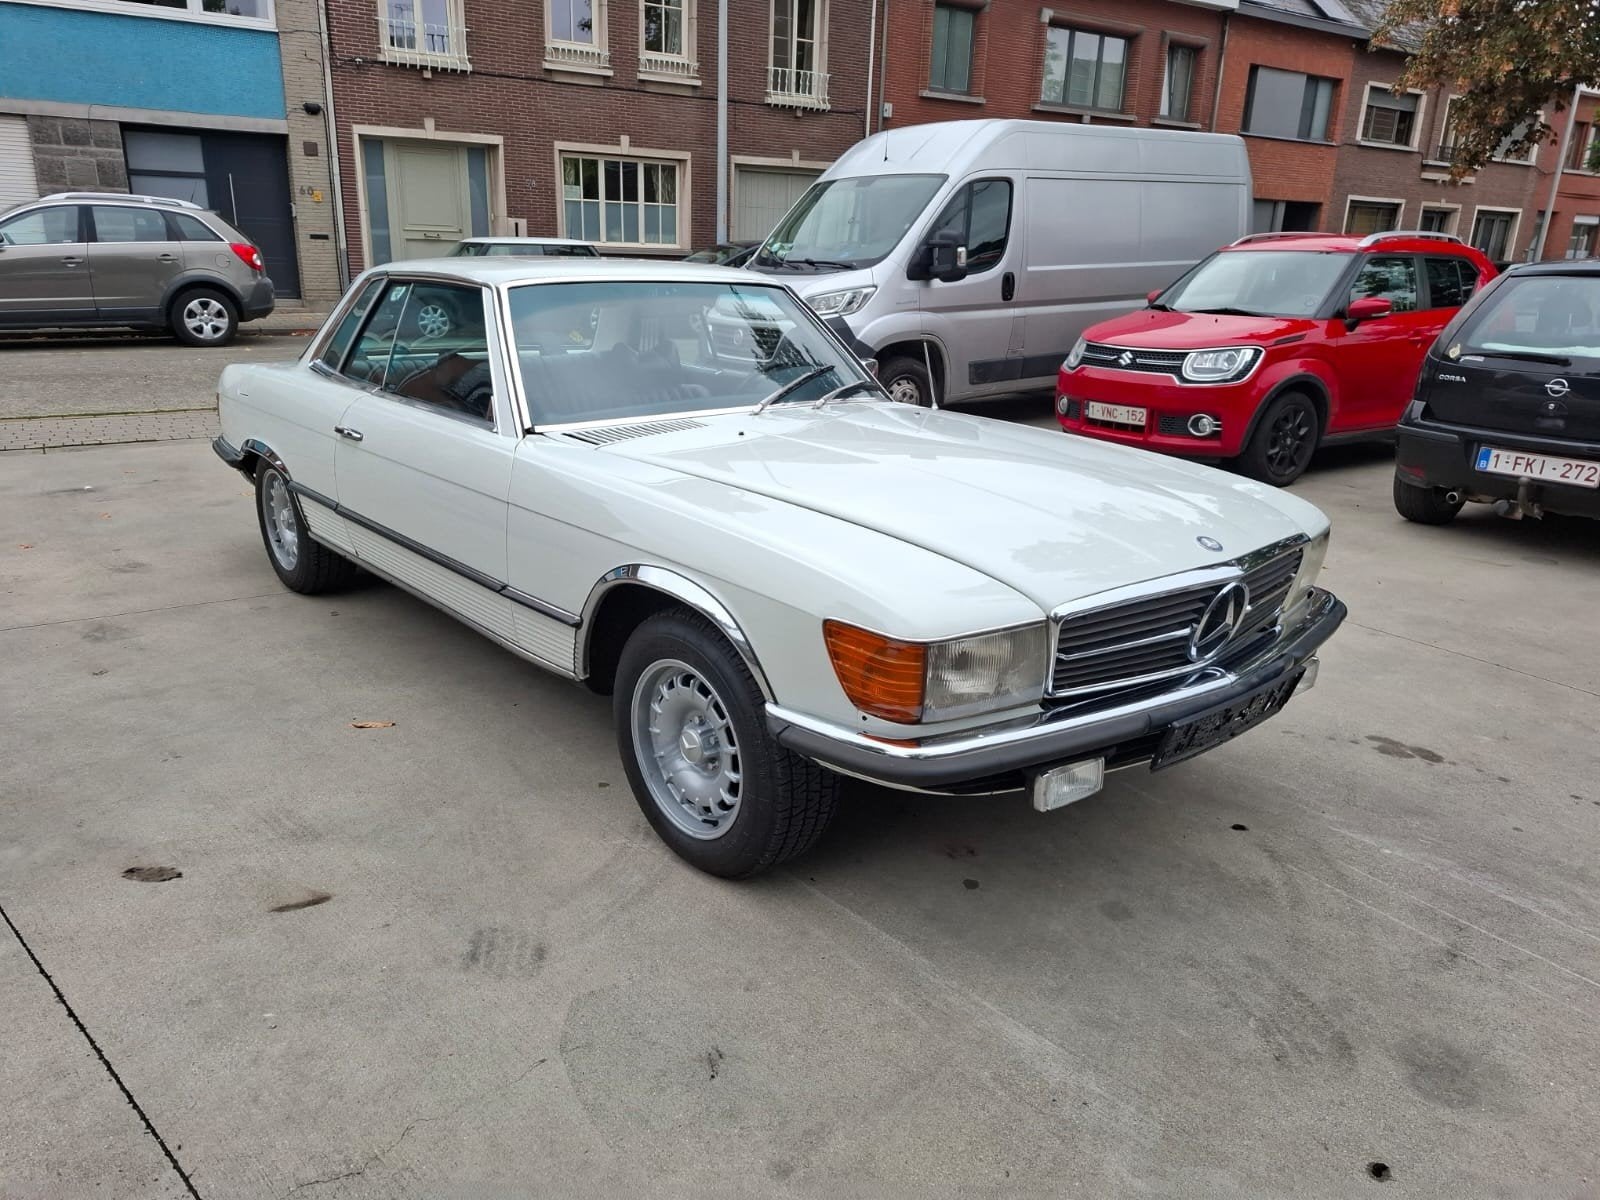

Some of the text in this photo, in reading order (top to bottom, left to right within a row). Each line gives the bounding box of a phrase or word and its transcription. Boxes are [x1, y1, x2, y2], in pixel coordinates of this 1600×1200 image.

[1439, 374, 1466, 383] CORSA
[1091, 404, 1145, 423] 1-VNC-152
[1479, 460, 1488, 468] B
[1493, 453, 1598, 482] 1-FKI-272
